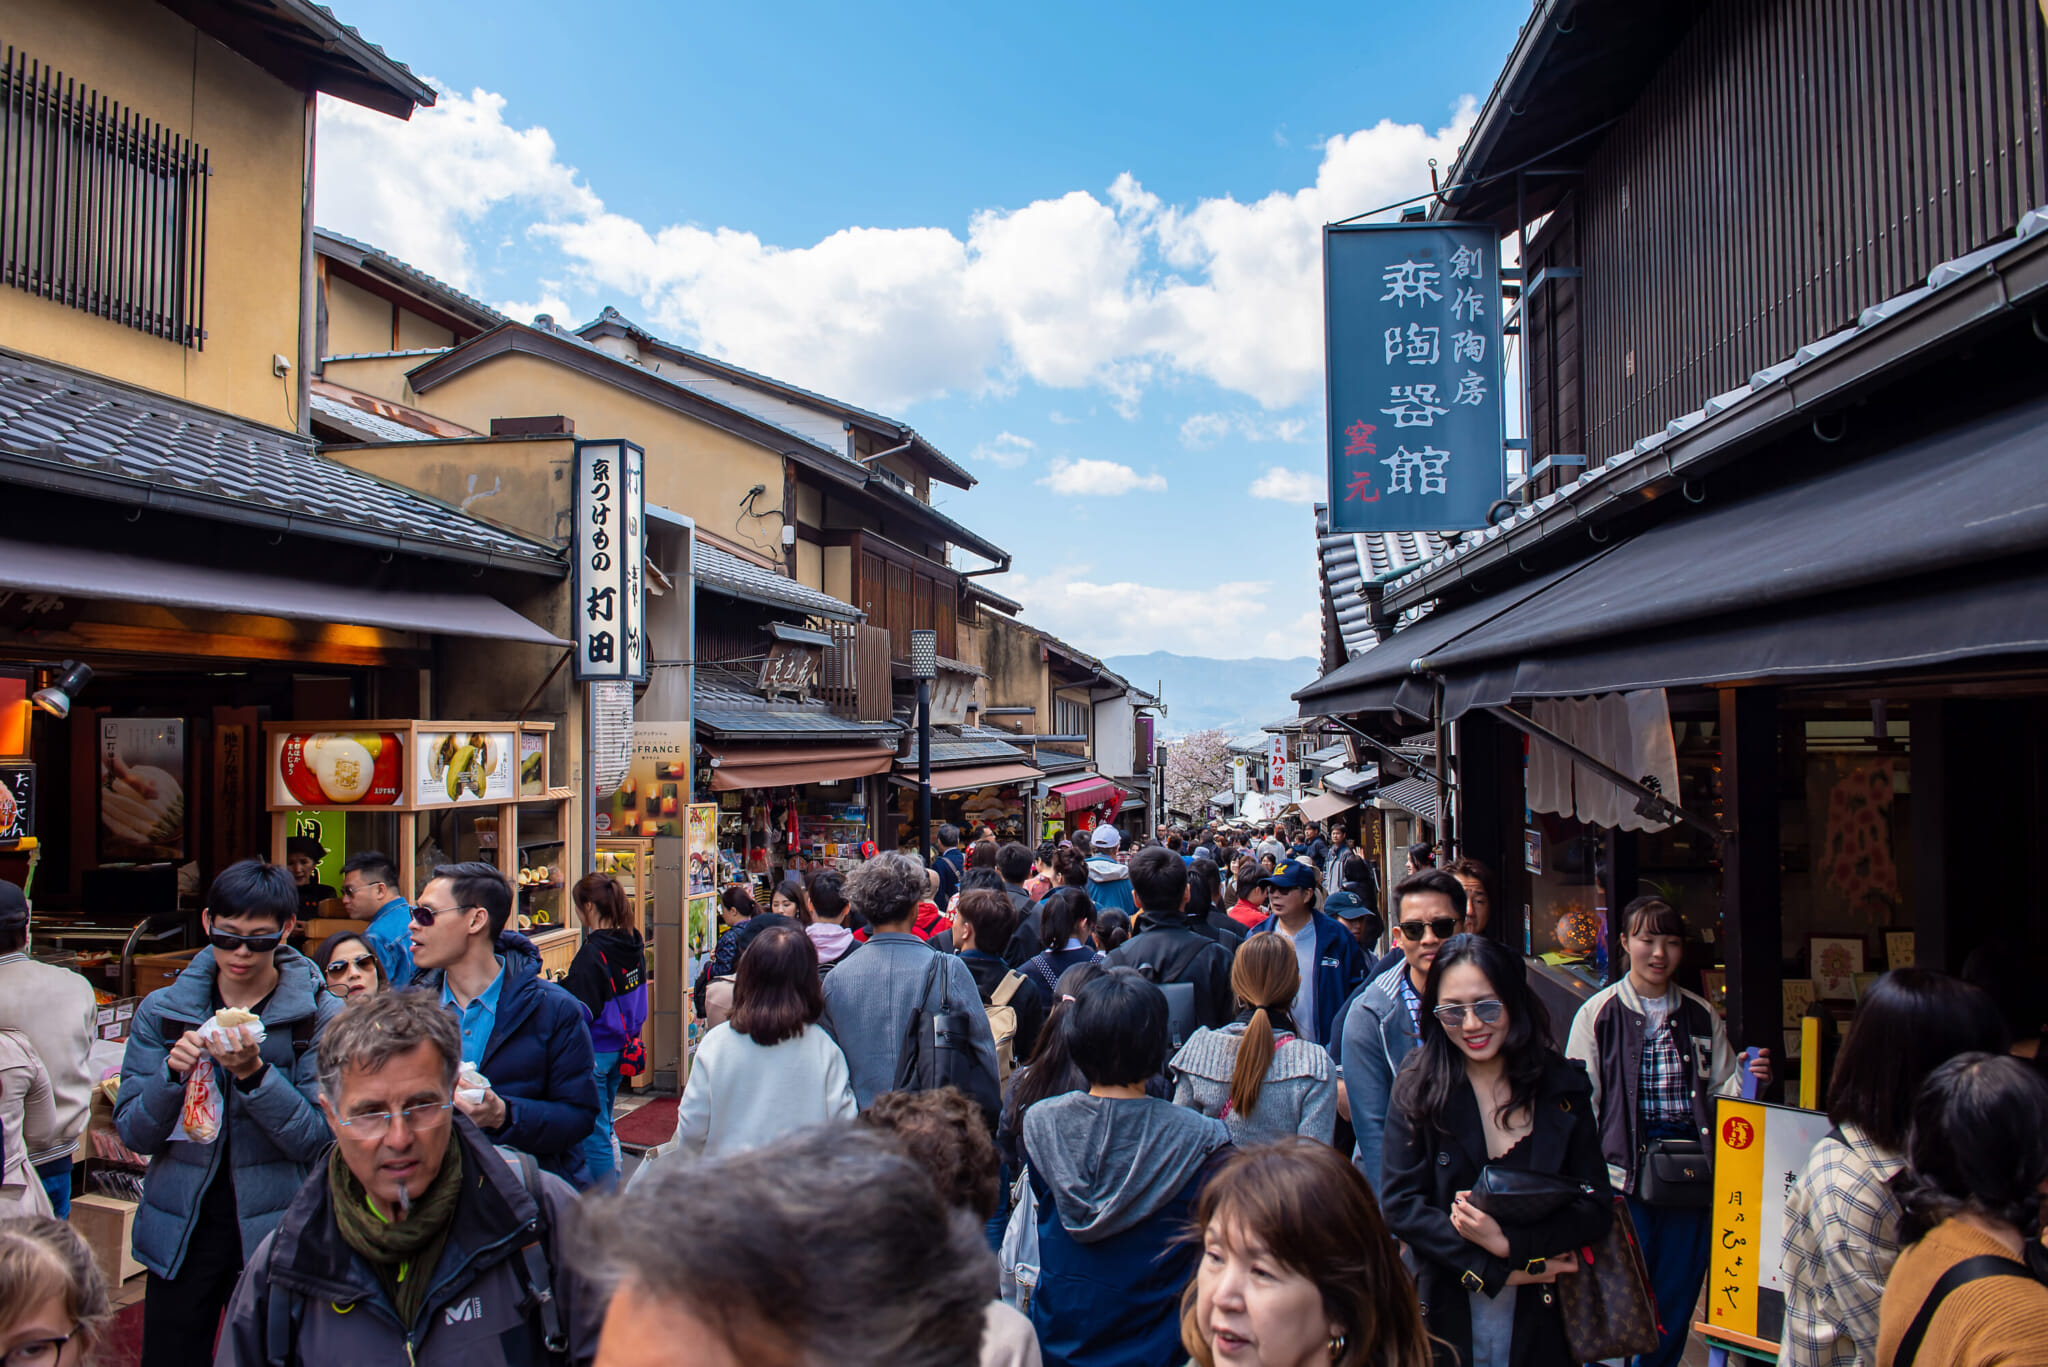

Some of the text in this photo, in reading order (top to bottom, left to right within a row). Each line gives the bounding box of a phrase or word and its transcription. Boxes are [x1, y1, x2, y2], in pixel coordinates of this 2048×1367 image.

[1379, 259, 1452, 496] 森陶器館
[1448, 244, 1488, 406] 創作陶房
[591, 458, 611, 572] 京つけもの
[1343, 419, 1380, 503] 窯元
[586, 586, 617, 664] 打田
